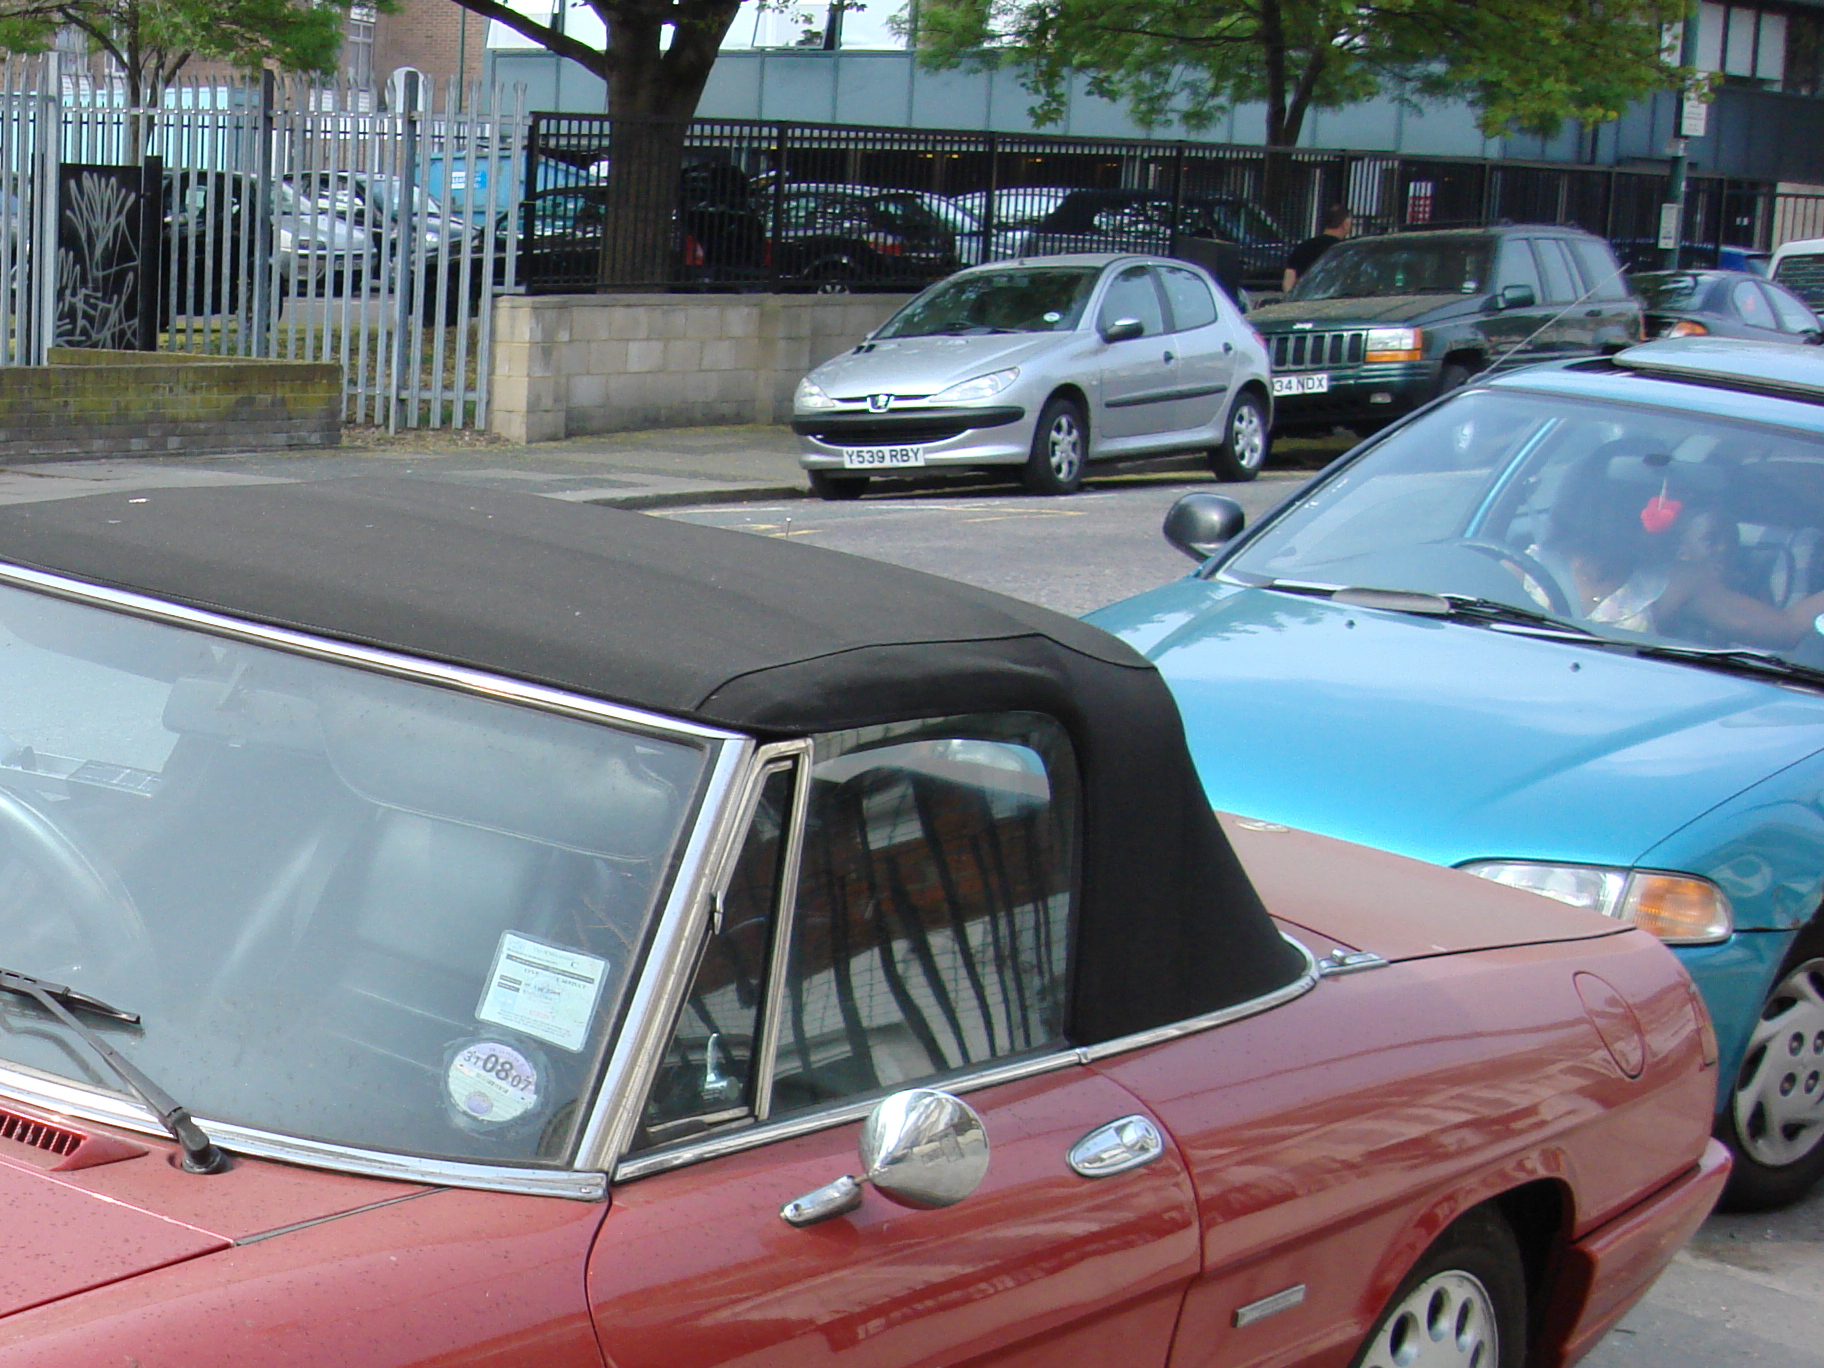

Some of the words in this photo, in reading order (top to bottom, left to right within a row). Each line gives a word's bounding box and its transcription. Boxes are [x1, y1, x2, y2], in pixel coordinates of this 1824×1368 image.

[1272, 379, 1293, 392] 34
[1297, 376, 1325, 392] NDX
[845, 450, 886, 465] Y539
[889, 448, 921, 464] RBY
[482, 1053, 514, 1081] 08
[510, 1073, 533, 1092] 07
